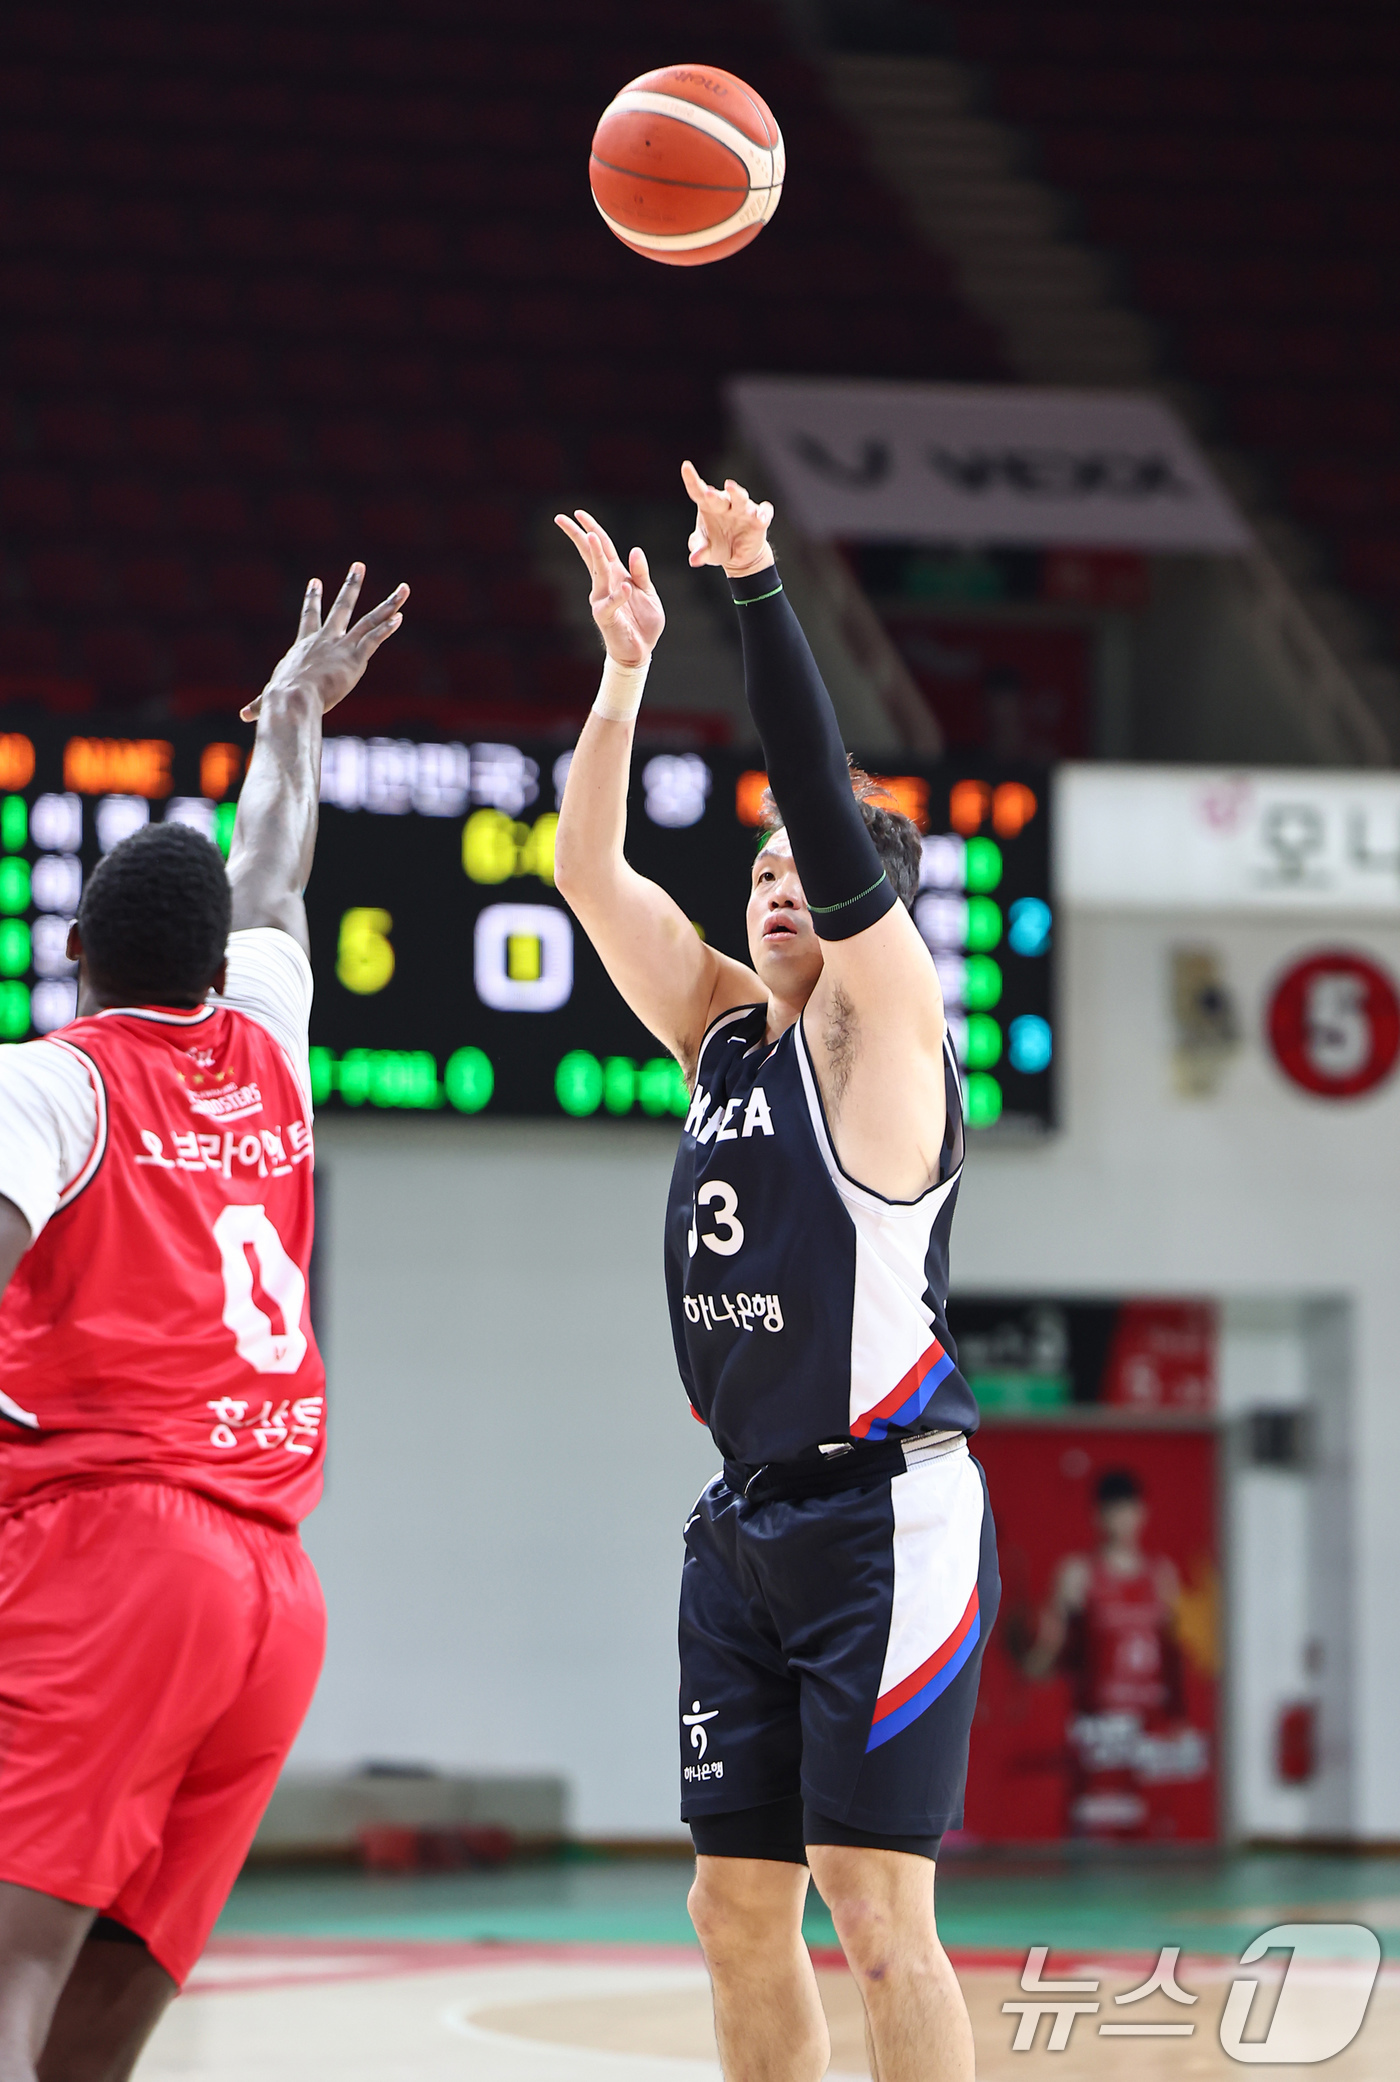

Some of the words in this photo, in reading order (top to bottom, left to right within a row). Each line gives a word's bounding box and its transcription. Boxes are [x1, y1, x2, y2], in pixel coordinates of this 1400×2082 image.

[1310, 970, 1372, 1080] 5
[135, 1119, 314, 1179] 오브라이언트
[213, 1204, 308, 1374] 0
[683, 1293, 785, 1333] 하나은행
[207, 1396, 325, 1455] 홍삼톤
[683, 1761, 724, 1783] 하나은행
